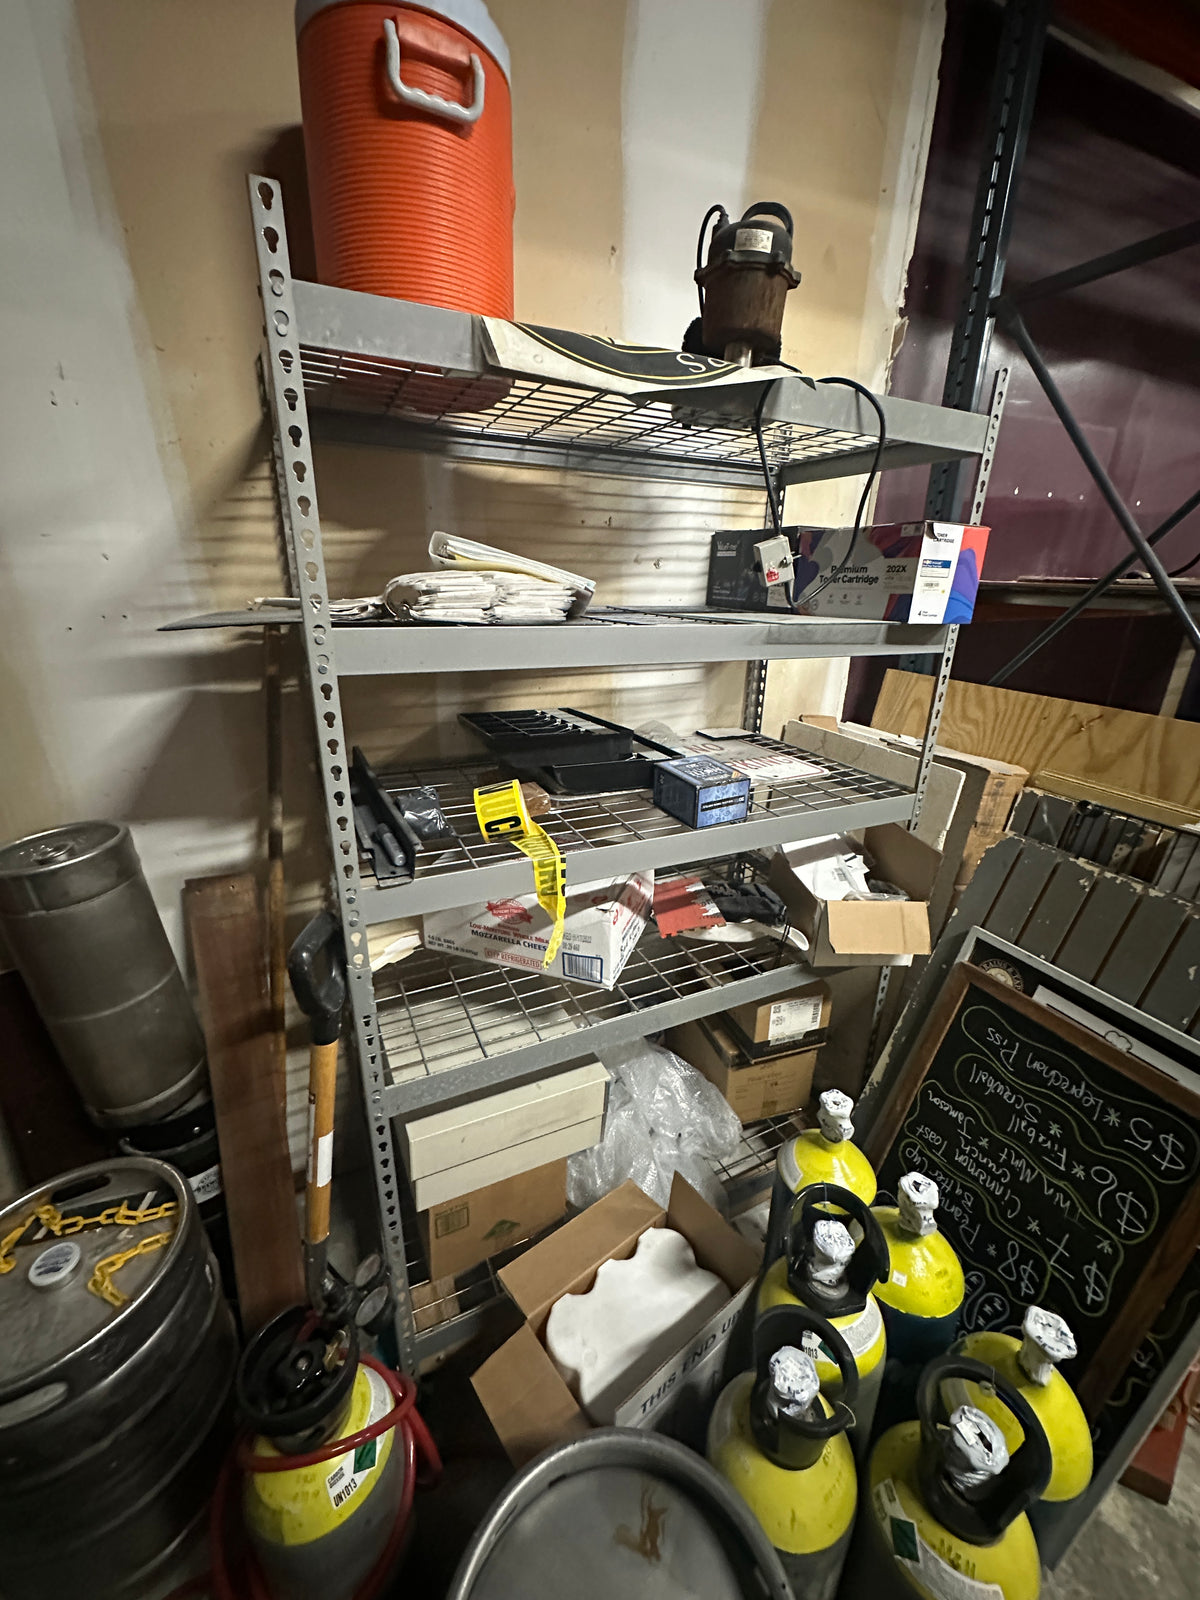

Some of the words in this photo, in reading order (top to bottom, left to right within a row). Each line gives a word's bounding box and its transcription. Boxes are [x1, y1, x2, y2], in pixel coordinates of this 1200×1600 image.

[819, 575, 841, 584] Toer
[841, 574, 879, 586] Cartridge
[830, 565, 868, 574] Pmium
[886, 565, 908, 573] 202X
[688, 743, 725, 754] NO
[727, 756, 793, 772] RKING
[471, 929, 521, 946] MOZZARELLA
[523, 940, 548, 952] CHEES
[501, 951, 541, 968] REFRIGERATED
[986, 1027, 1020, 1072] Piss
[968, 1063, 1042, 1124] Screwball
[927, 1090, 976, 1140] Jameson
[915, 1124, 948, 1163] Toast
[1007, 1114, 1068, 1172] Fireball
[1122, 1117, 1186, 1171] $5
[953, 1149, 1022, 1219] Cinnamon
[998, 1147, 1040, 1184] Mint
[937, 1188, 982, 1252] Peanu
[1090, 1166, 1148, 1235] $6
[998, 1241, 1040, 1297] $8
[1045, 1233, 1109, 1306] $7
[641, 1371, 677, 1414] THIS
[682, 1333, 717, 1374] END
[722, 1309, 741, 1335] UP
[803, 1346, 819, 1360] 1013
[334, 1478, 357, 1507] UN1013
